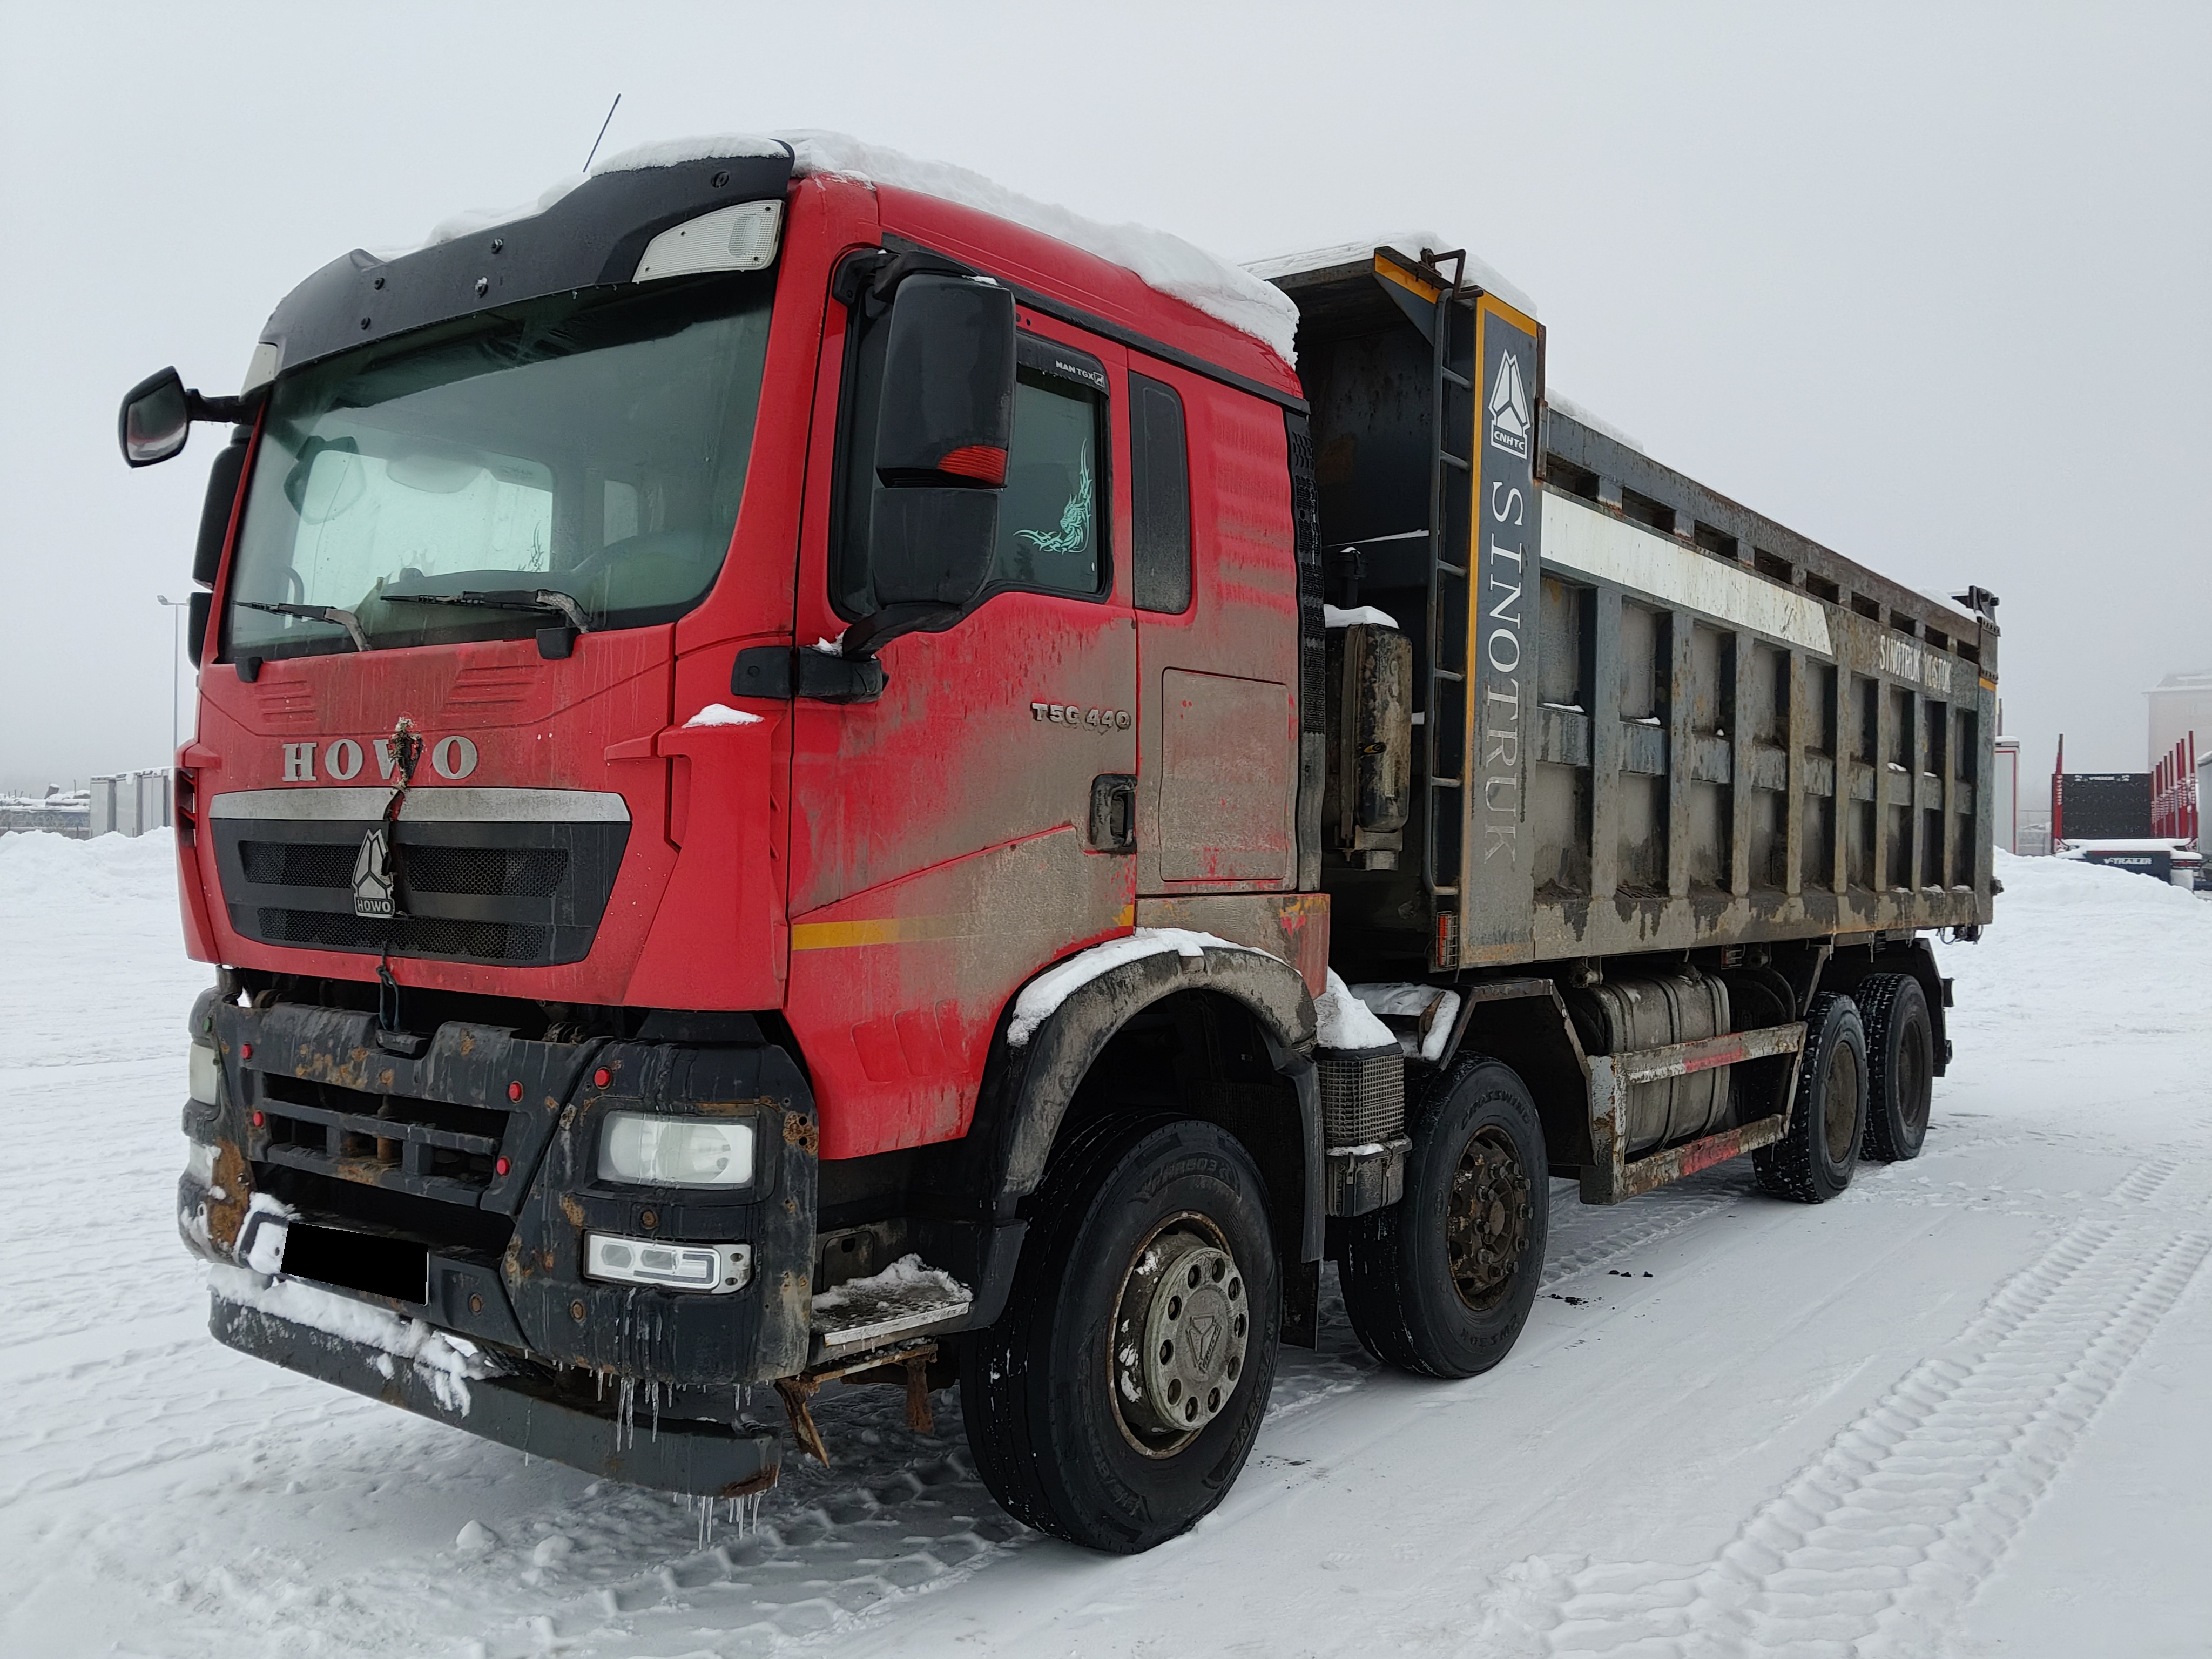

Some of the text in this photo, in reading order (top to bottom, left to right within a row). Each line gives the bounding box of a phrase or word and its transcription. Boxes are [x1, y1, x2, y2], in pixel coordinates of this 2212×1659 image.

[1076, 368, 1094, 380] TGX
[1494, 430, 1525, 450] CNHTC
[1483, 481, 1525, 864] SINOTRUK
[1030, 702, 1131, 730] T5G 440
[356, 900, 392, 913] HOWO
